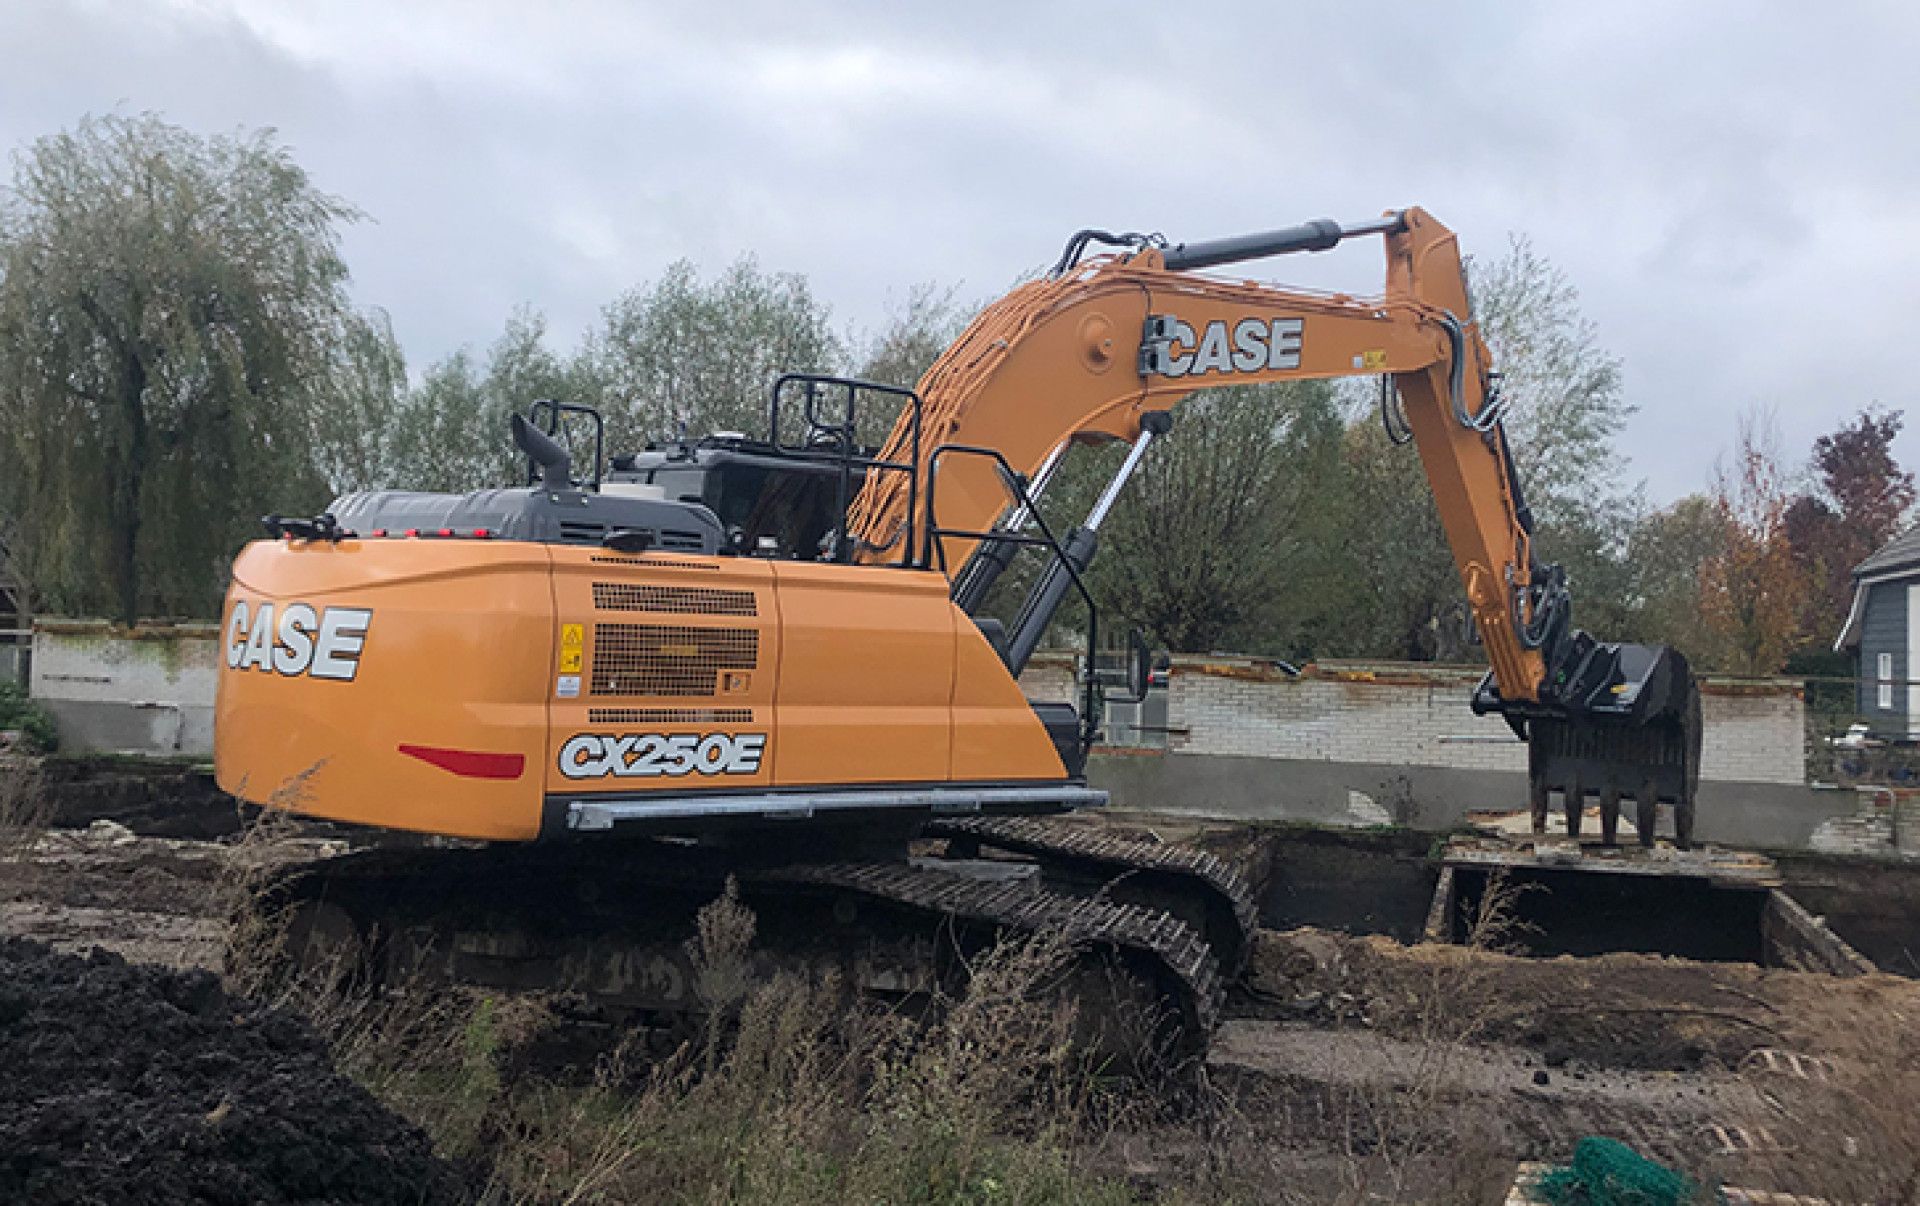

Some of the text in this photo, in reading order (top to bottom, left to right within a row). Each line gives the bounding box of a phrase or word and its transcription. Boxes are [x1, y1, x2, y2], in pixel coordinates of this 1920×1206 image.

[1157, 318, 1304, 377] CASE
[227, 600, 373, 681] CASE
[559, 732, 767, 778] CX250E
